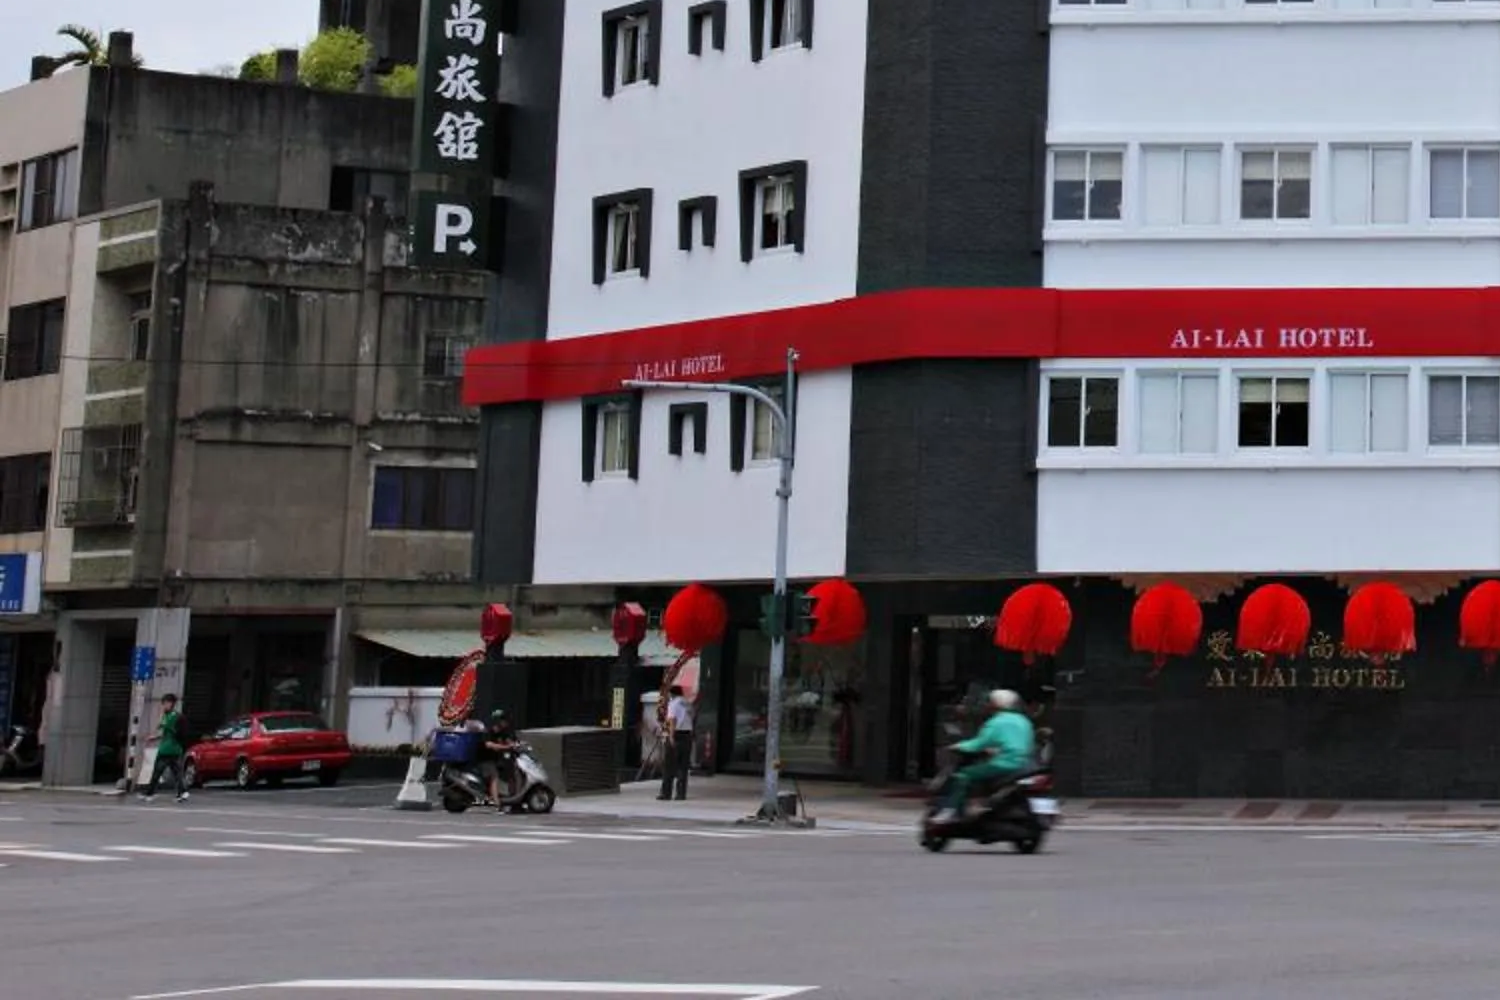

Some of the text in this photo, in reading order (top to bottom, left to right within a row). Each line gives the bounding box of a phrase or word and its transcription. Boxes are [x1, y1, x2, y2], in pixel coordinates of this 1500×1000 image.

[433, 203, 473, 254] P
[1170, 327, 1374, 348] AI-LAI HOTEL
[634, 353, 725, 382] AI-LAI HOTEL
[1206, 667, 1406, 689] AI-LAI HOTEL
